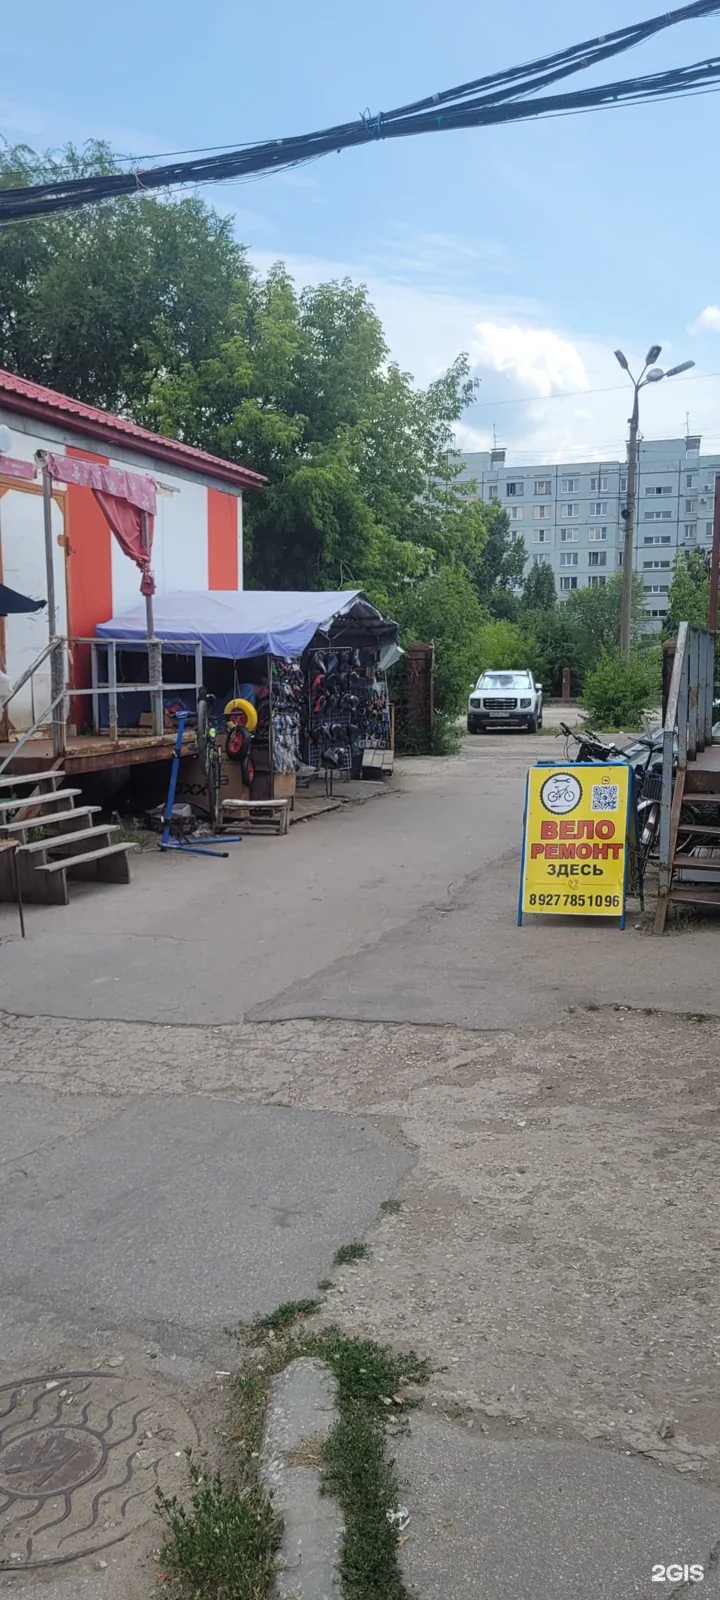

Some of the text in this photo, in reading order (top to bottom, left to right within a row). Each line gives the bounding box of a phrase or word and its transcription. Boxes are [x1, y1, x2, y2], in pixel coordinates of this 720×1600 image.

[540, 820, 616, 840] ВЕЛО
[530, 843, 624, 860] РЕМОНТ
[547, 864, 604, 877] ЗДЕСЬ
